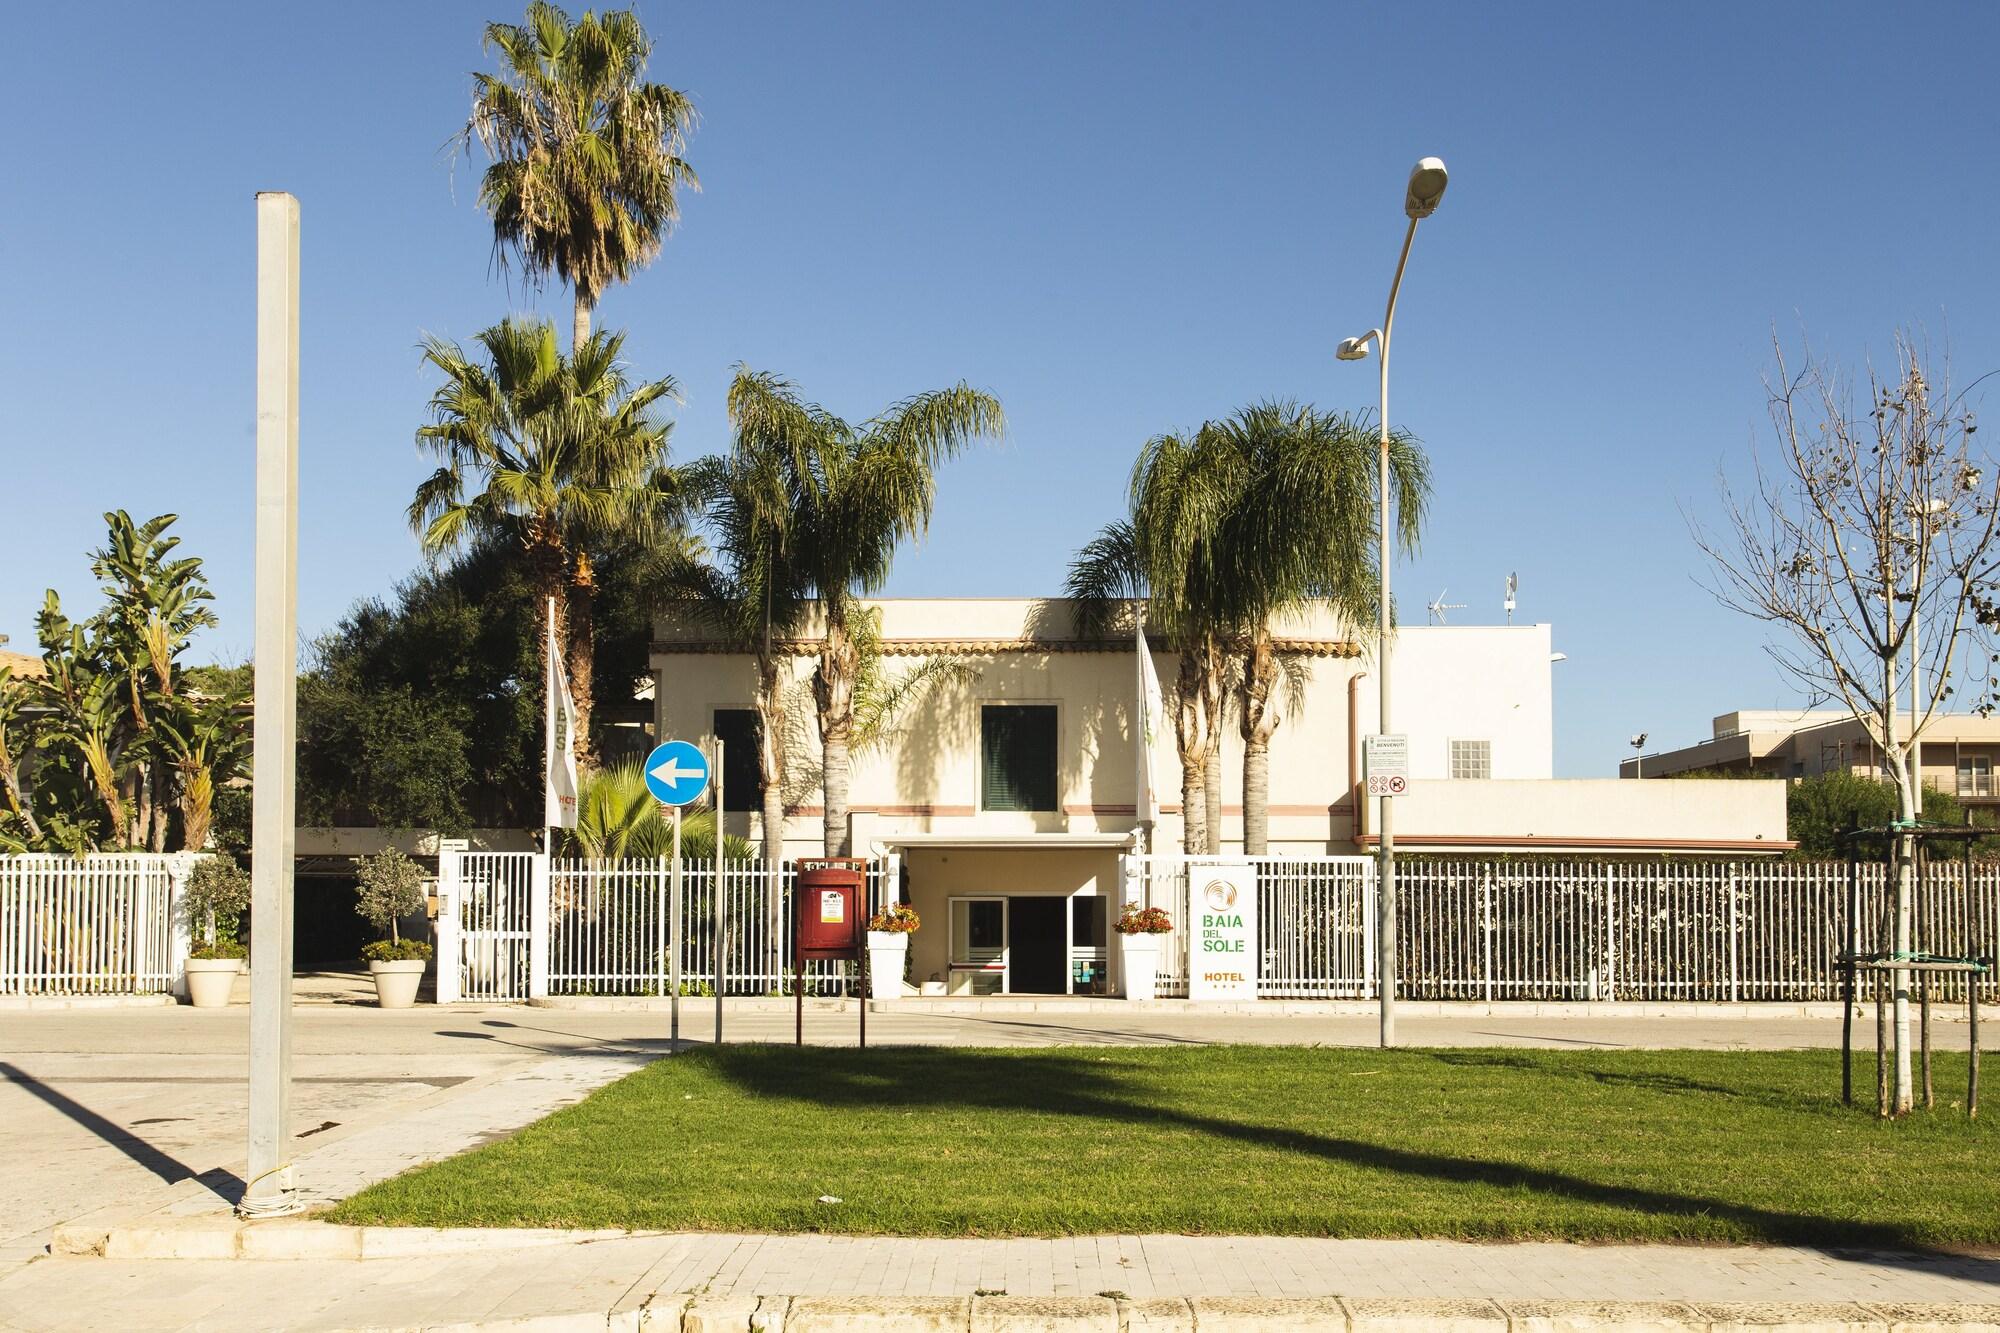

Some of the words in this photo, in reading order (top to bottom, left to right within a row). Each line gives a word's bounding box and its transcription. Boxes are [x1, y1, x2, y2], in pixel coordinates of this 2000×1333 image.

[1203, 915, 1243, 927] BAIA
[1203, 930, 1222, 938] DEL
[1203, 940, 1245, 952] SOLE
[1204, 973, 1245, 981] HOTEL
